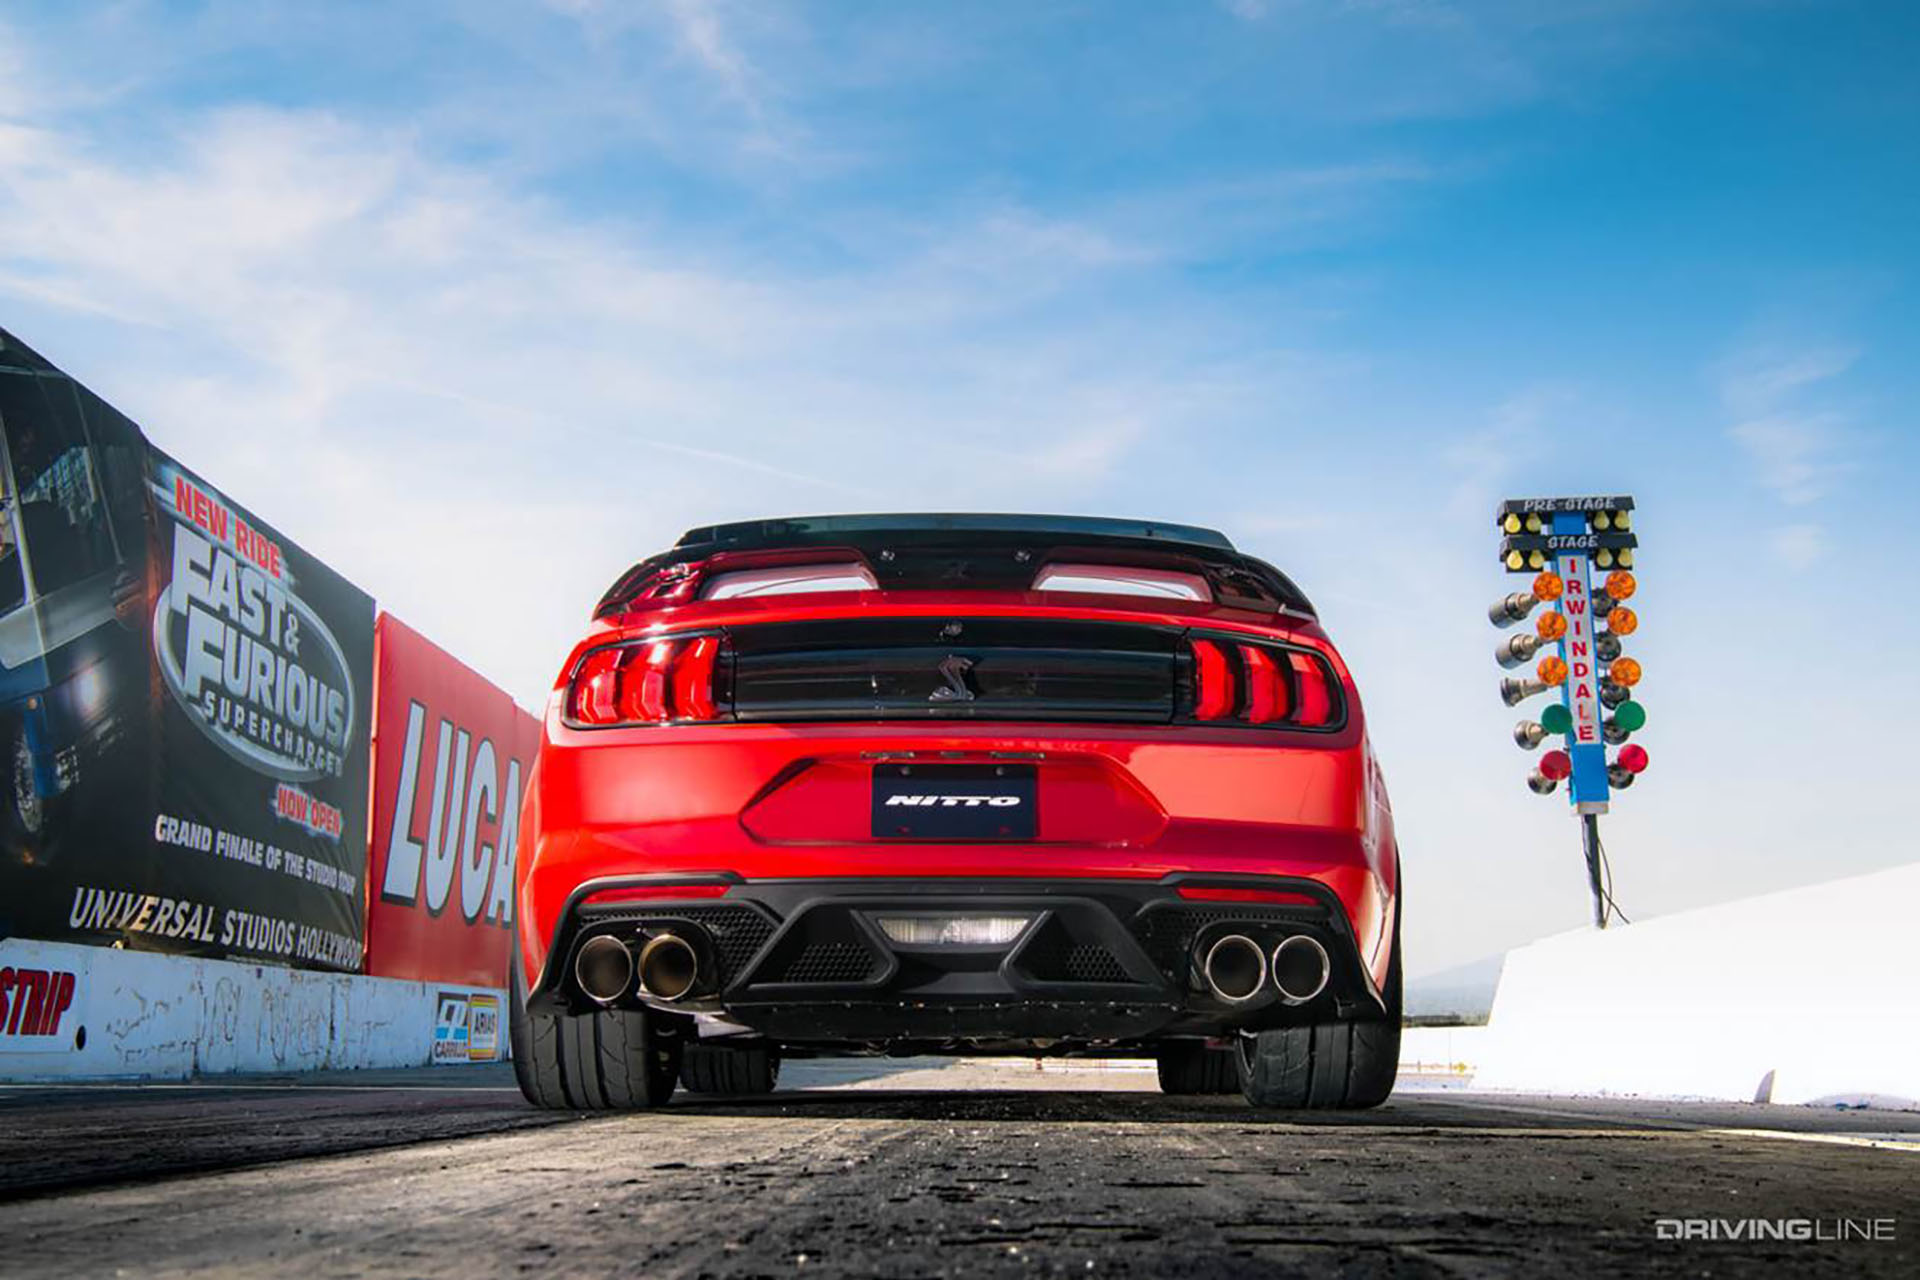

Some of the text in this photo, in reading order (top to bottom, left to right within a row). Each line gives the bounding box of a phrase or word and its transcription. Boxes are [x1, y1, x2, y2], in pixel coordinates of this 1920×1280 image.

[175, 475, 281, 578] NEW RIDE
[1523, 497, 1616, 511] PRE-STAGE
[1547, 535, 1599, 548] STAGE
[170, 522, 300, 656] FAST &
[183, 604, 347, 748] FURIOUS
[1565, 558, 1595, 742] IRWINDALE
[278, 785, 341, 838] NOW OPEN
[885, 795, 1021, 806] NITTO
[155, 814, 212, 852] GRAND
[216, 831, 264, 867] FINALE
[265, 845, 282, 871] OF
[284, 851, 304, 877] THE
[305, 858, 338, 889] STUDIO
[69, 887, 361, 969] UNIVERSAL STUDIOS HOLLYWOOD
[0, 967, 76, 1036] STRIP
